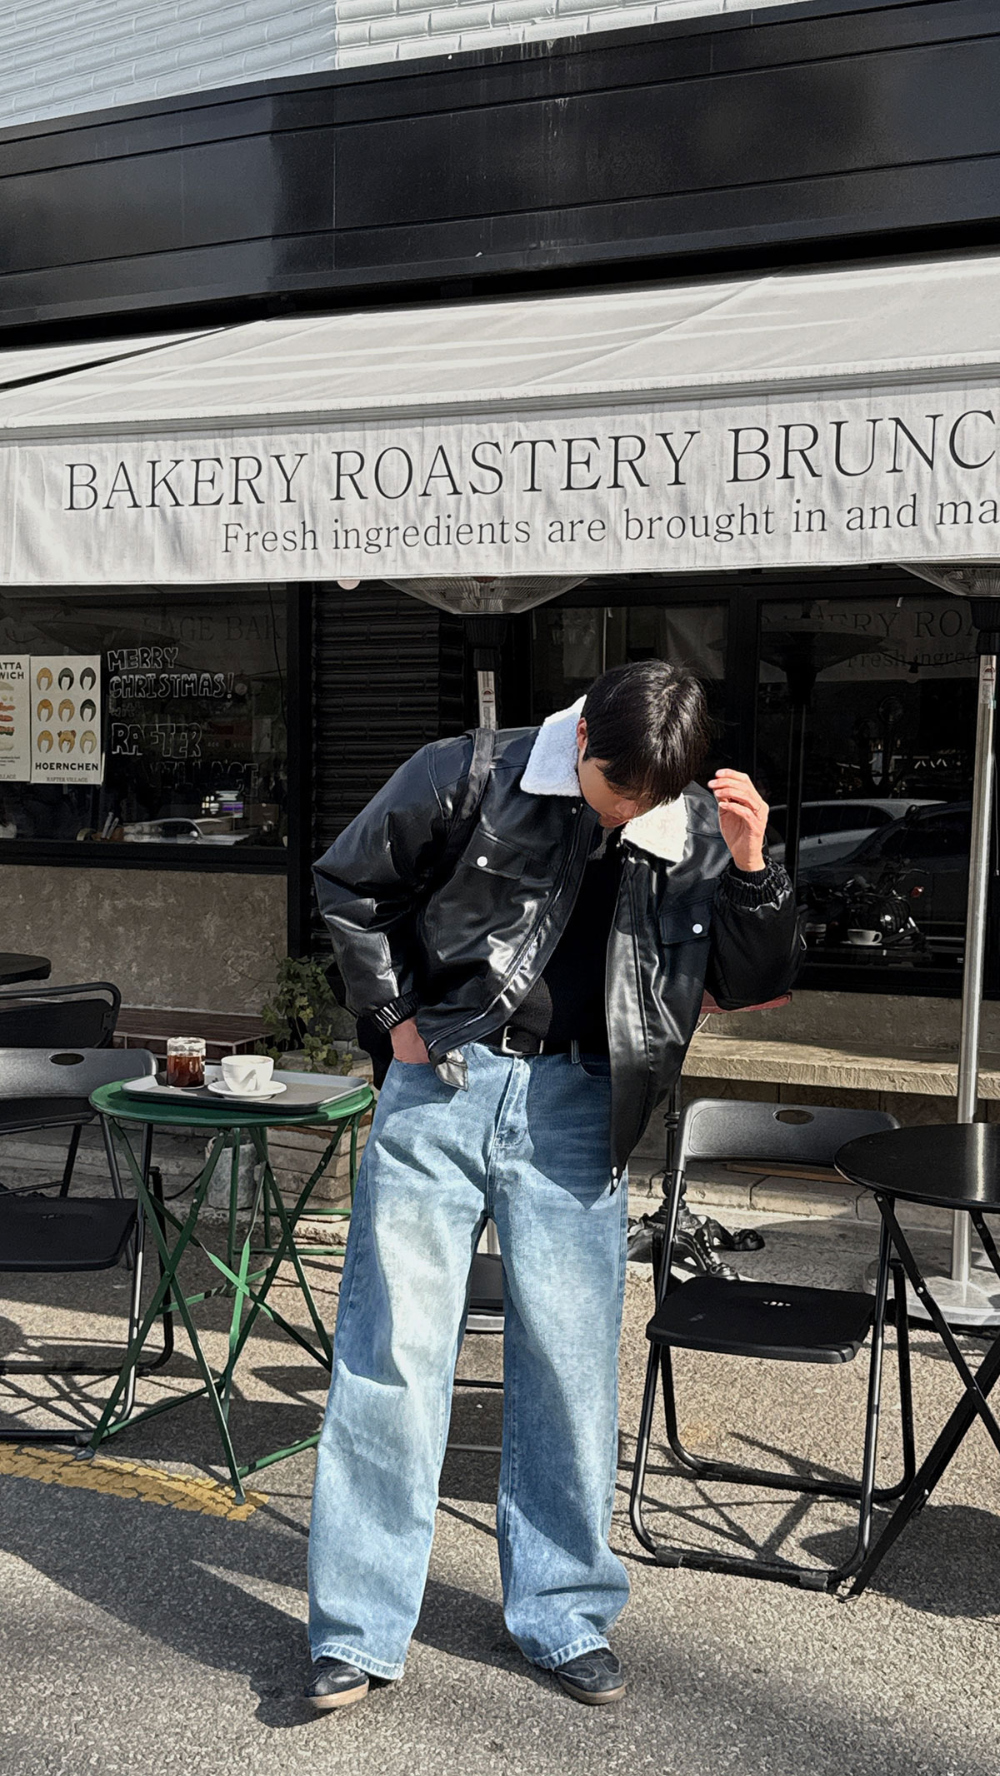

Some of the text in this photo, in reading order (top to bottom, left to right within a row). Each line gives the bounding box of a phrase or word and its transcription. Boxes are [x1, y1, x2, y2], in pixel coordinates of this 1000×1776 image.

[64, 410, 997, 511] BAKERY ROASTERY BRUNC
[221, 493, 1000, 555] Fresh ingredients are brought in and ma
[107, 646, 178, 672] MERRY
[109, 672, 235, 699] CHRISTMAS!
[111, 722, 202, 759] RAFTER
[35, 762, 99, 771] HOERNCHEN
